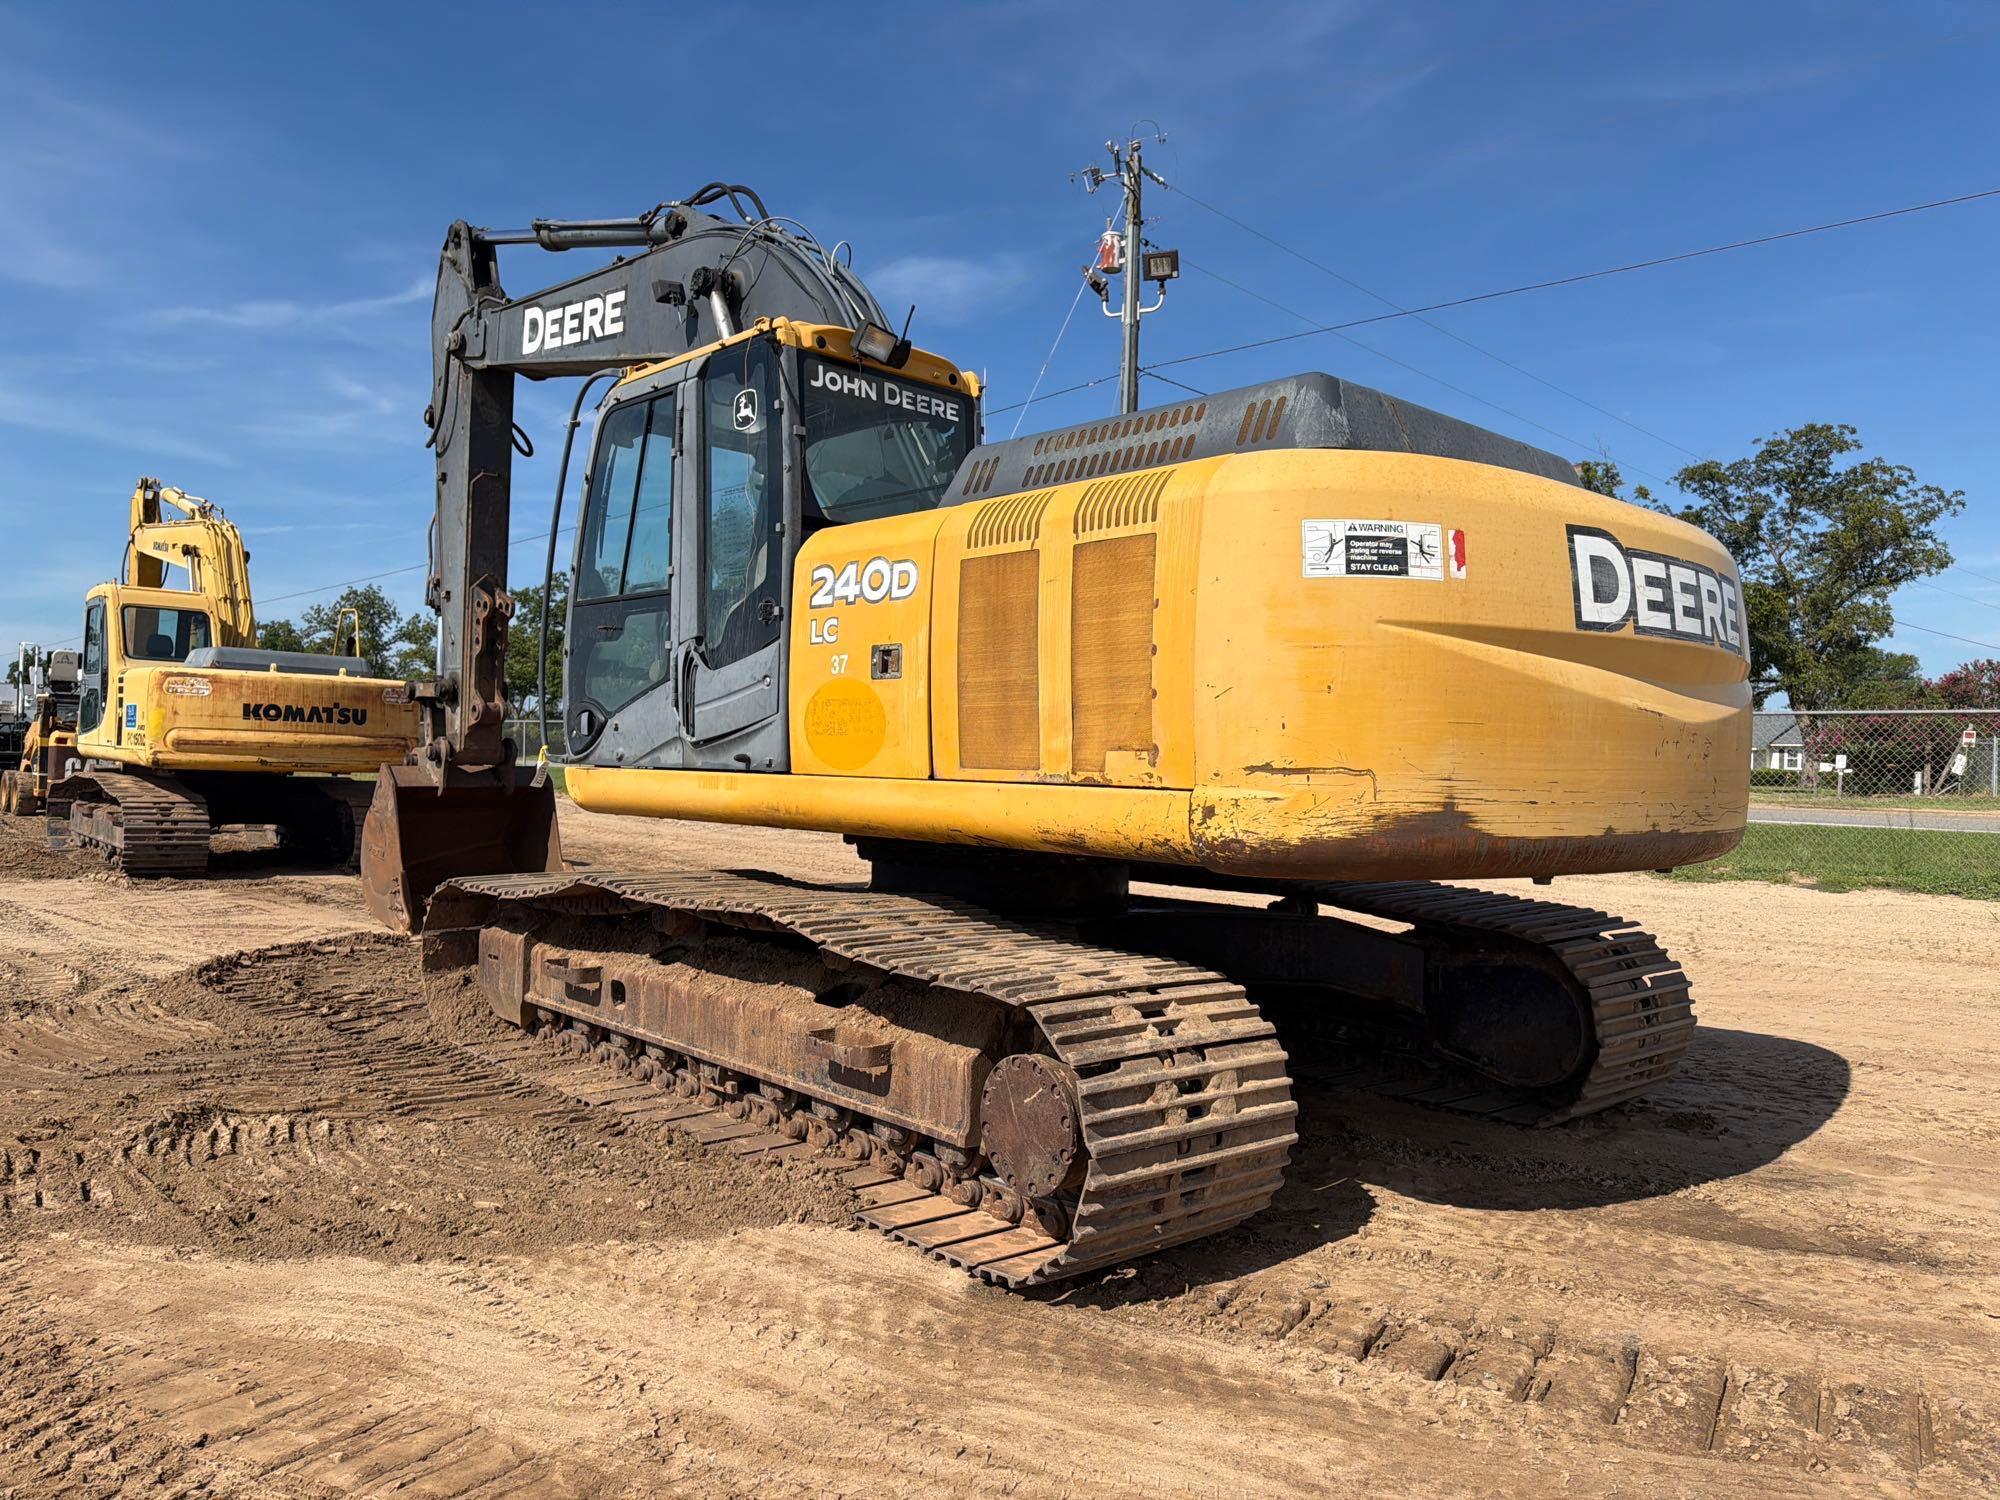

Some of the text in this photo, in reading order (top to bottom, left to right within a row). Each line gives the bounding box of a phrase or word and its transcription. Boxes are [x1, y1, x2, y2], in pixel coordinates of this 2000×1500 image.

[522, 290, 626, 355] DEERE
[810, 364, 960, 422] JOHN DEERE
[1358, 523, 1404, 533] WARNING
[1350, 547, 1370, 555] swing
[1350, 563, 1399, 571] STAY CLEAR
[810, 557, 919, 608] 240D
[1573, 533, 1741, 648] DEERE
[810, 617, 839, 645] LC
[831, 655, 848, 675] 37
[242, 703, 367, 726] KOMATSU
